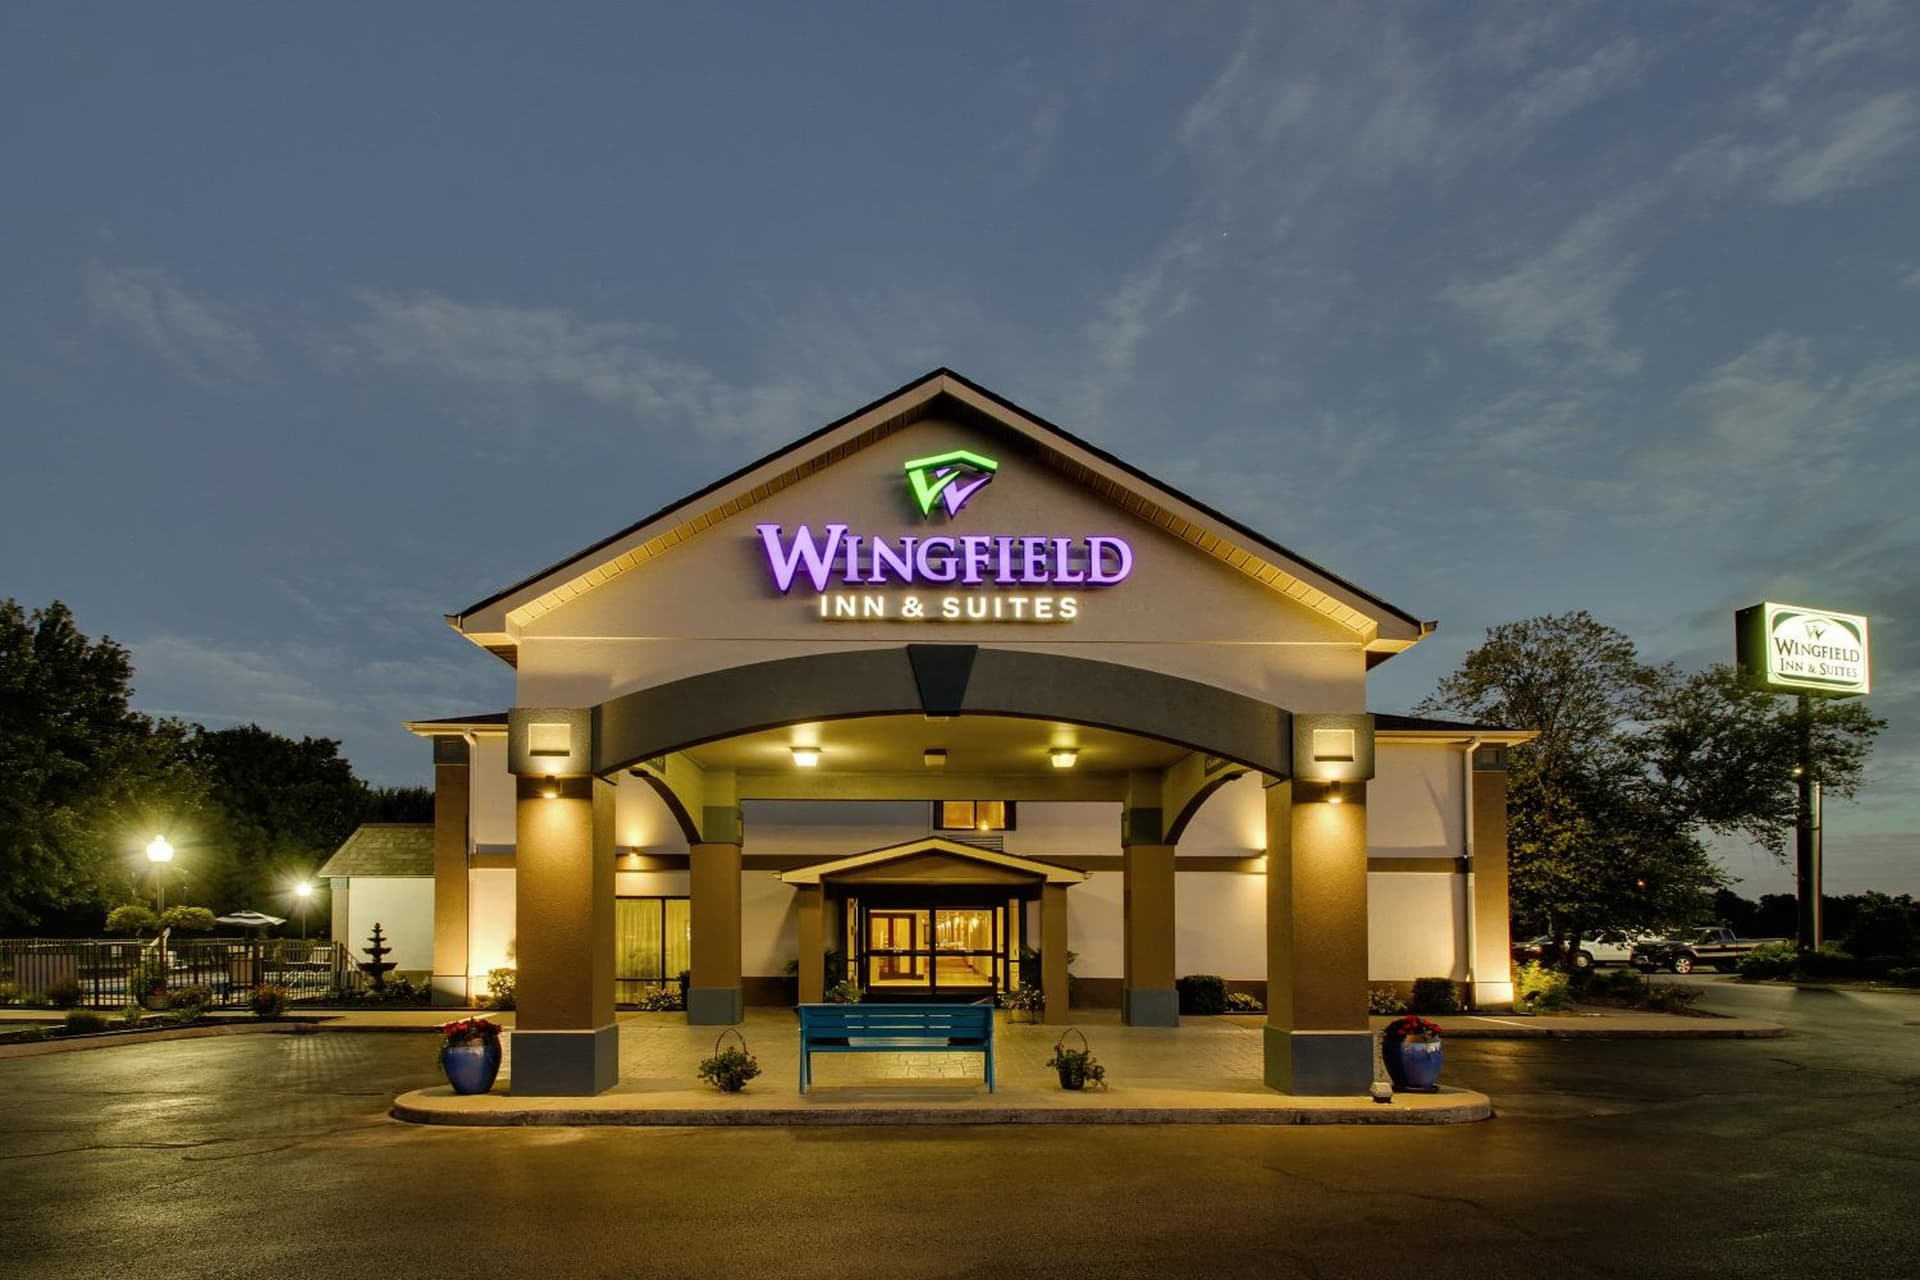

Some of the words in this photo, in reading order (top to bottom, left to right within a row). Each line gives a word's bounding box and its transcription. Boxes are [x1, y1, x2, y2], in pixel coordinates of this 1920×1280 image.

[755, 523, 1134, 592] WINGFIELD
[819, 595, 884, 617] INN
[902, 598, 924, 618] &
[942, 596, 1078, 618] SUITES
[1773, 637, 1860, 663] WINGFIELD
[1780, 657, 1803, 671] INN
[1808, 665, 1817, 674] &
[1819, 662, 1858, 678] SUITES
